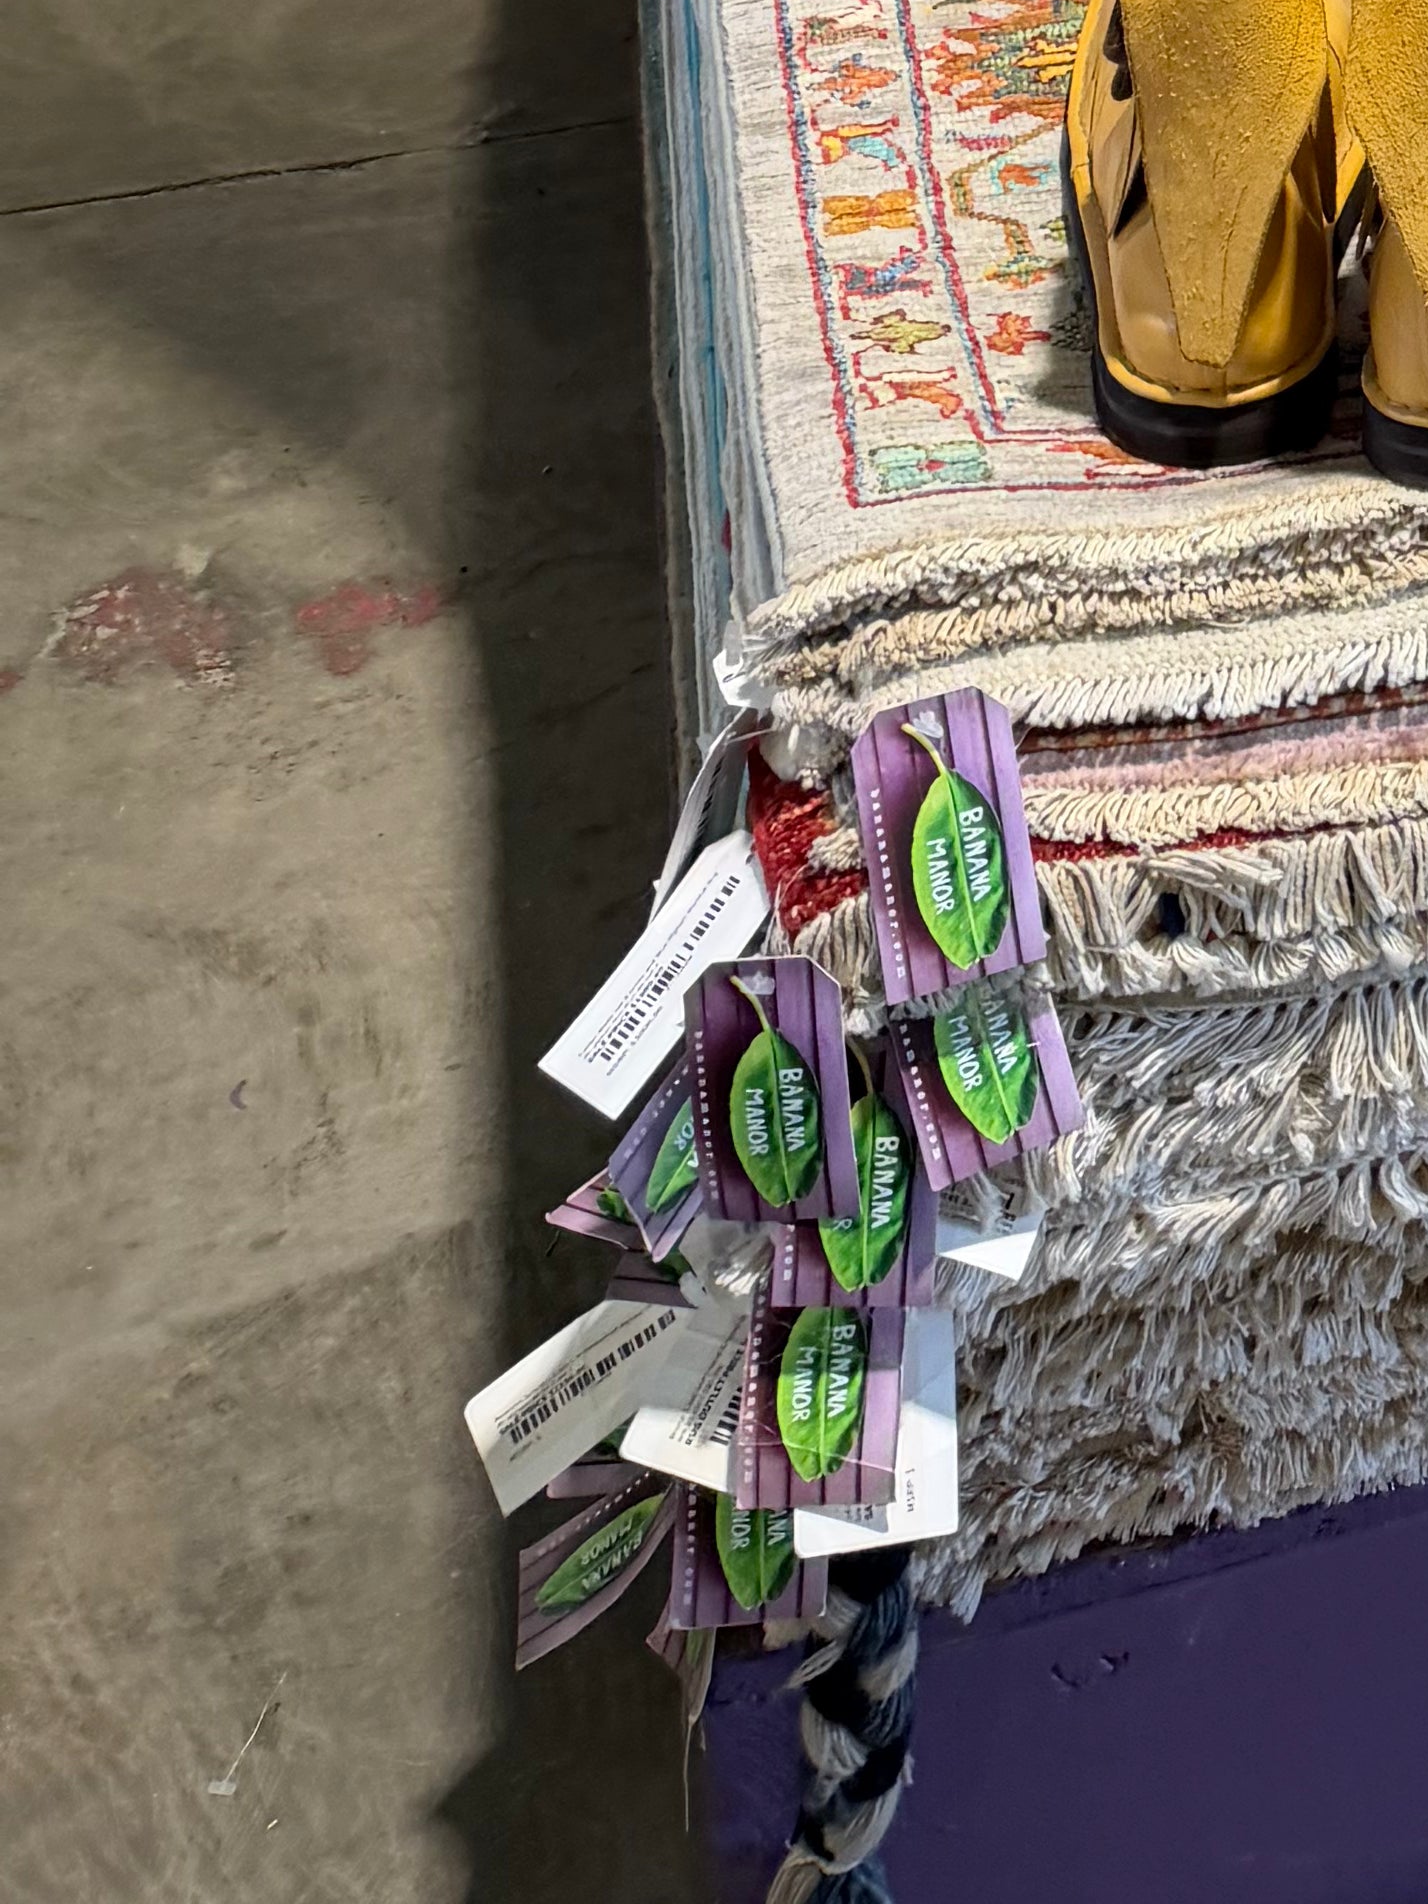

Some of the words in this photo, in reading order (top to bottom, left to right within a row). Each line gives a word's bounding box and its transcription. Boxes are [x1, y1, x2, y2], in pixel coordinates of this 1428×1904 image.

[926, 837, 955, 916] MANOR
[959, 806, 991, 903] BANANA
[948, 1014, 983, 1093] MANOR
[980, 994, 1019, 1076] ANANA
[745, 1088, 768, 1156] MANOR
[778, 1067, 806, 1153] BANANA
[871, 1135, 901, 1229] BANANA
[791, 1345, 818, 1423] MANOR
[826, 1323, 857, 1419] BANANA
